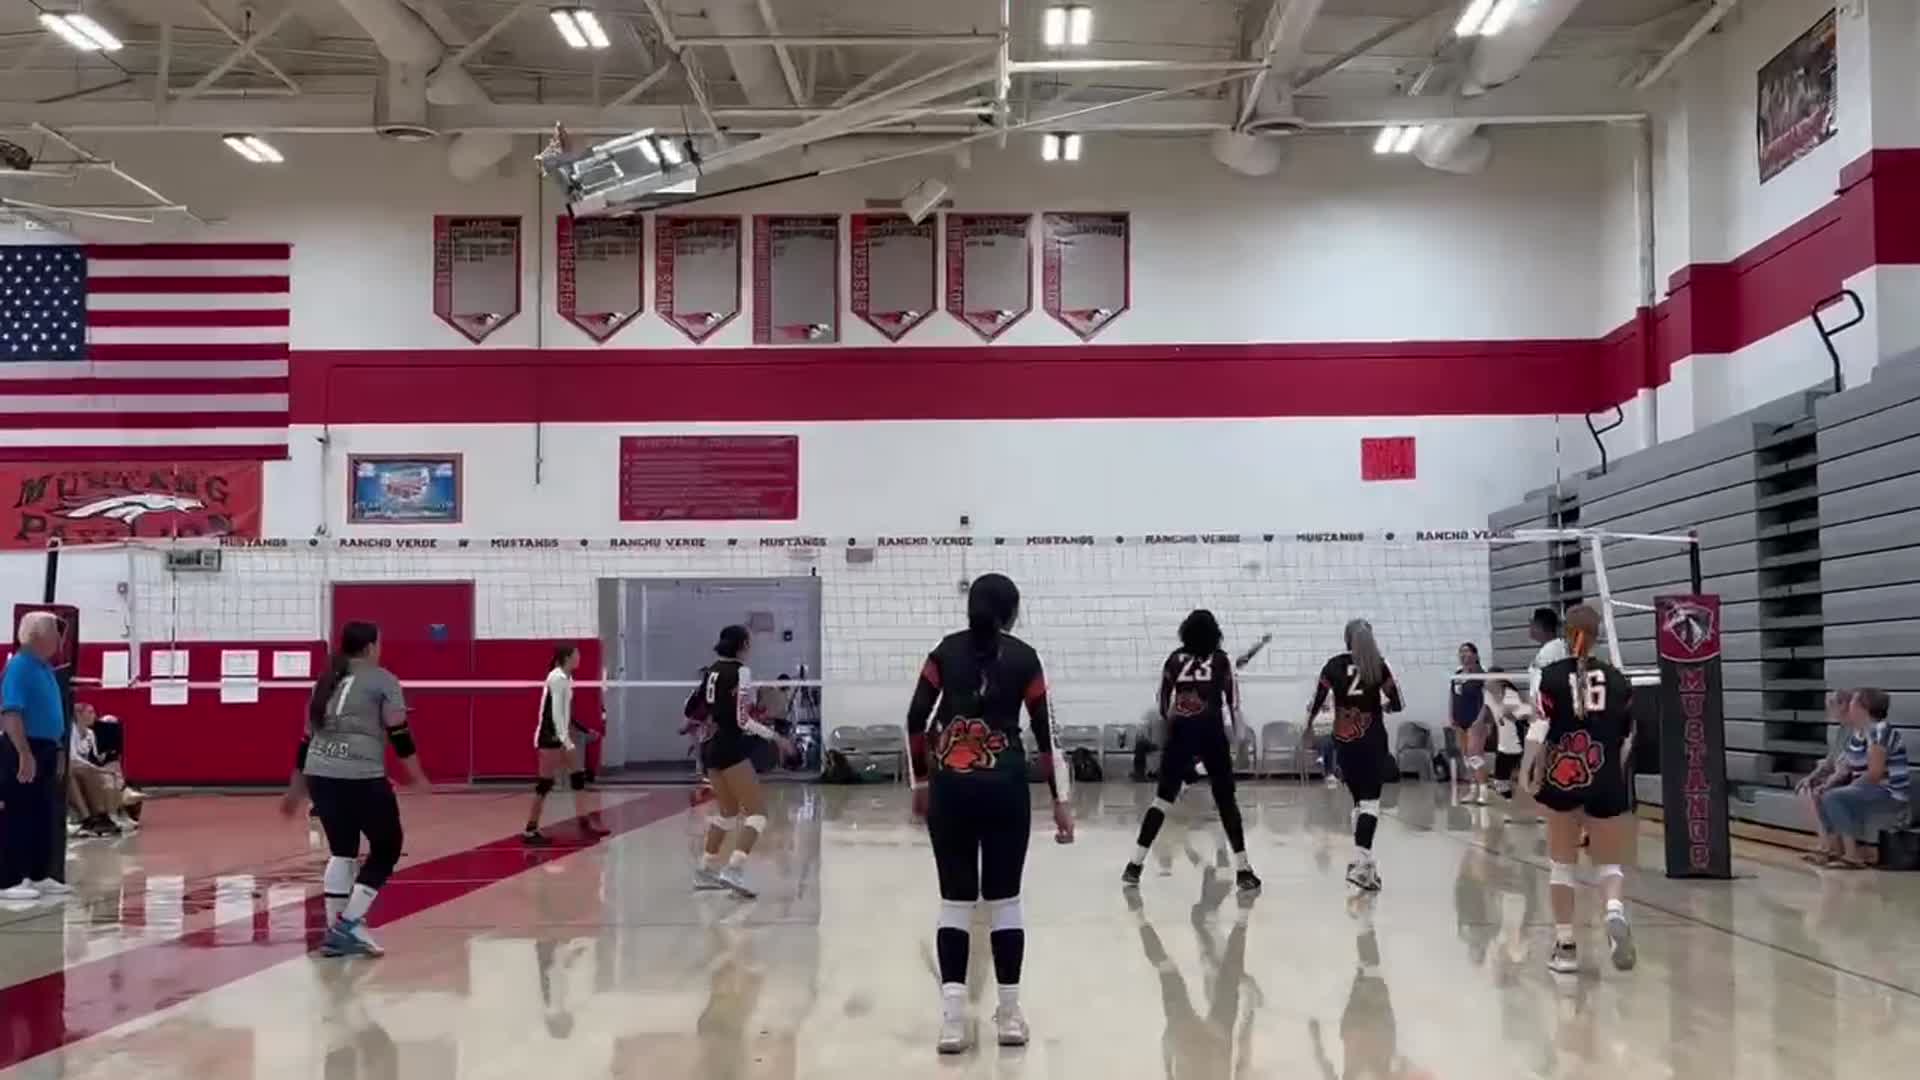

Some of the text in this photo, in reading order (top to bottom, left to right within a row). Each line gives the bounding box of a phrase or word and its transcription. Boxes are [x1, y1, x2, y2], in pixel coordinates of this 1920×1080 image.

[339, 538, 391, 548] RANCHO
[396, 538, 437, 548] VERDE
[490, 538, 559, 548] MUSTANGS
[610, 538, 660, 548] RANCHO
[665, 538, 706, 548] VERDE
[759, 537, 827, 547] MUSTANGS
[877, 537, 928, 546] RANCHO
[932, 537, 973, 546] VERDE
[1026, 535, 1095, 545] MUSTANGS
[1145, 534, 1197, 544] RANCHO
[1201, 534, 1241, 543] VERDE
[1296, 532, 1364, 542] MUSTANGS
[1416, 530, 1468, 541] RANCHO
[1176, 653, 1213, 682] 23
[1346, 665, 1363, 696] 2
[1568, 669, 1607, 713] 16
[1678, 667, 1711, 870] MUSTANGS
